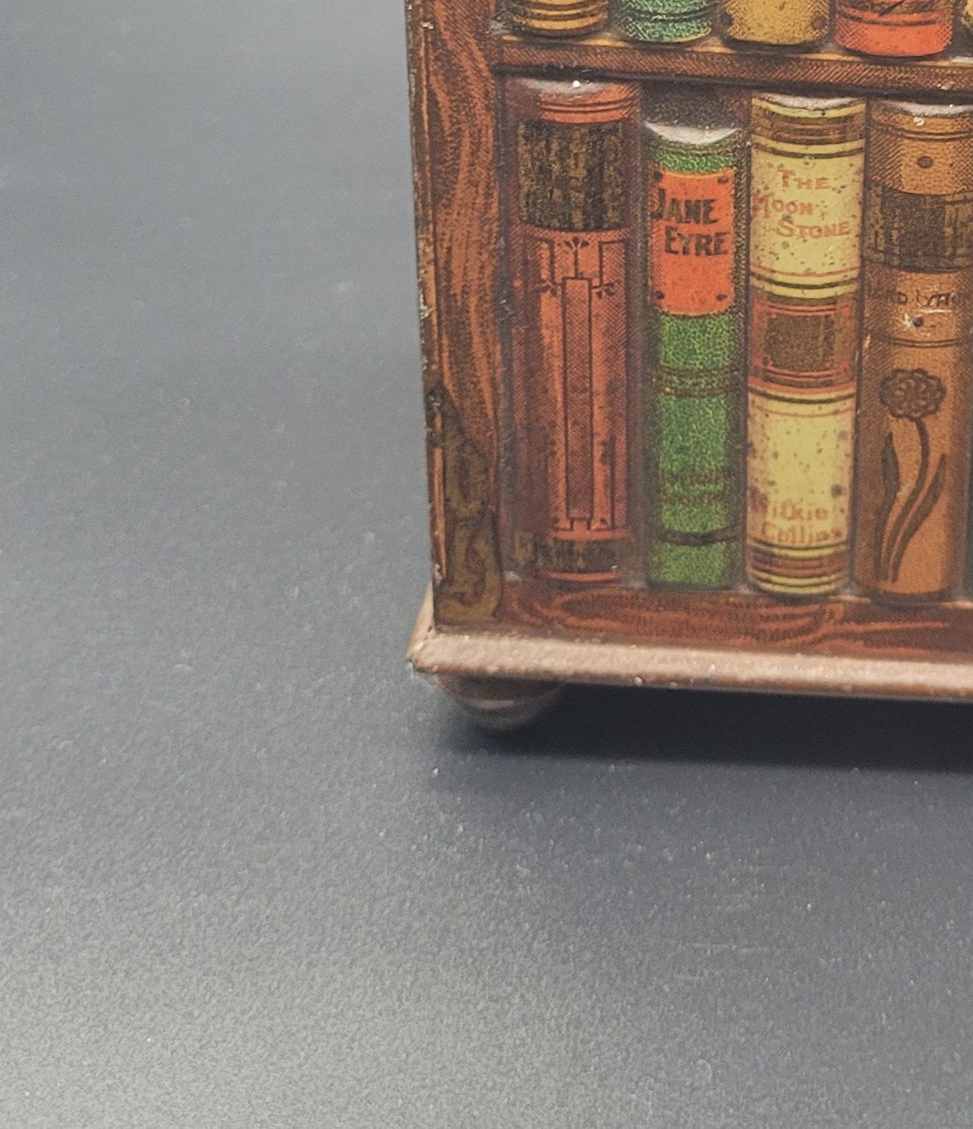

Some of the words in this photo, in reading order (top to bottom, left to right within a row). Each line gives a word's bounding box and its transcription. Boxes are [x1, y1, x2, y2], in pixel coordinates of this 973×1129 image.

[776, 168, 831, 191] THE
[650, 187, 718, 225] JANE
[751, 192, 814, 220] MOON
[664, 224, 732, 257] EYRE
[778, 217, 852, 239] STONE
